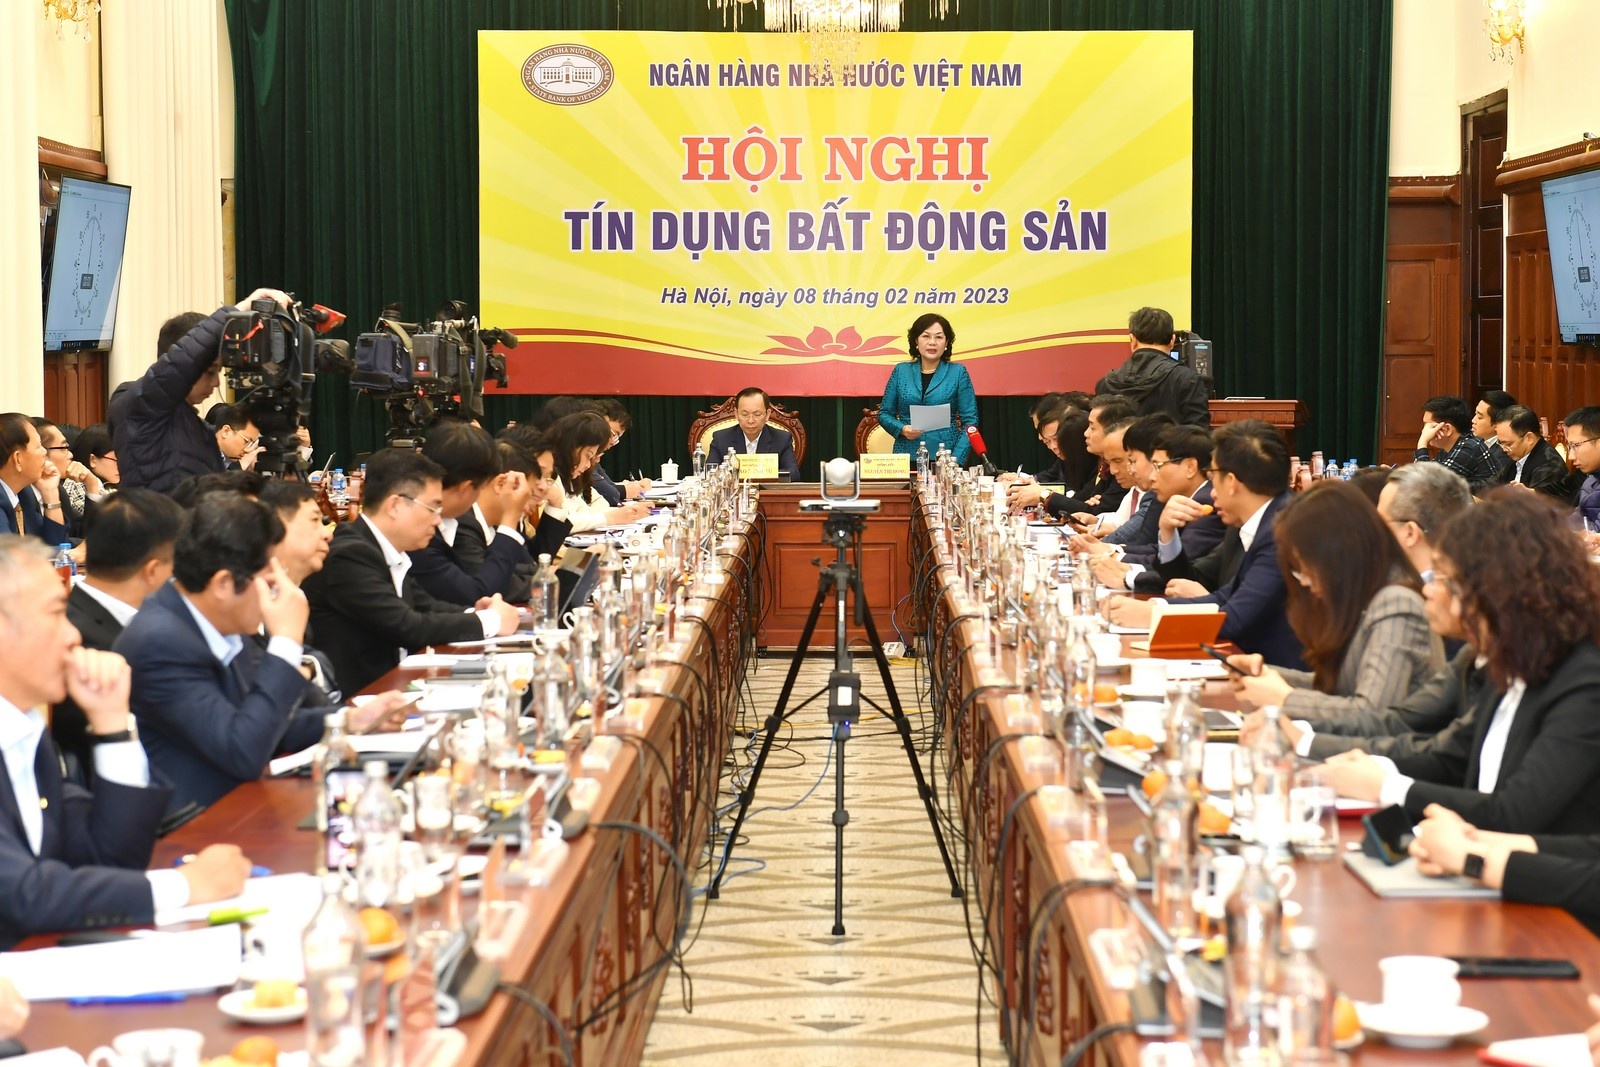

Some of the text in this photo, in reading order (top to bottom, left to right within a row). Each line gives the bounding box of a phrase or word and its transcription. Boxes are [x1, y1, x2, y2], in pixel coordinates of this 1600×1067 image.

[552, 46, 569, 55] NHÀ
[603, 65, 611, 80] NAM
[650, 59, 1022, 92] NGÂN HÀNG NHÀ NƯỚC VIỆT NAM
[530, 85, 605, 103] STATE BANK OF VIETNAM
[682, 126, 989, 193] HỘI NGHỊ
[564, 197, 1107, 261] TÍN DỤNG BẤT ĐỘNG SẢN
[661, 286, 1009, 308] Hà Nội, ngày 08 tháng 02 năm 2023
